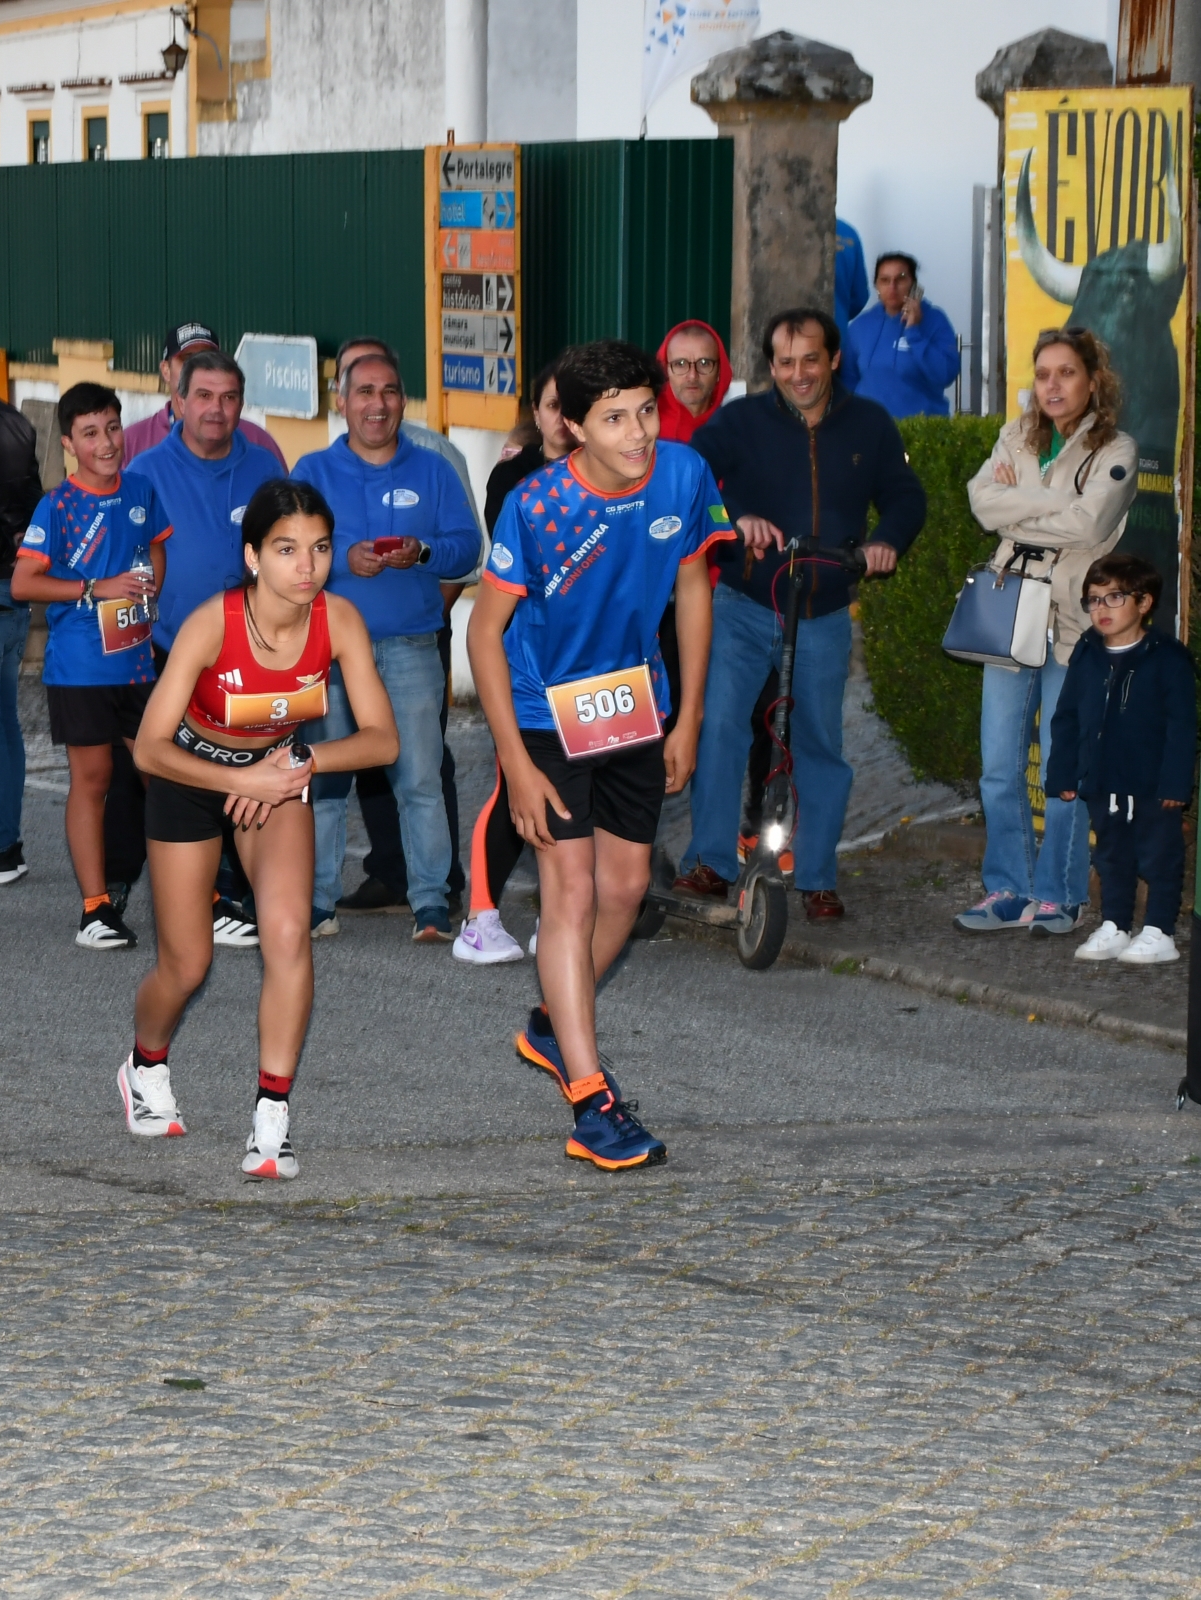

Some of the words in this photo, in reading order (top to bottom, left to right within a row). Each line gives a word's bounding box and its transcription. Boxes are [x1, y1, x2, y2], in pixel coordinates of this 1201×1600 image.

[457, 157, 512, 183] Portalegre
[443, 289, 480, 310] histórico
[443, 332, 475, 349] municipal
[265, 359, 308, 392] Piscina
[444, 361, 481, 385] turismo
[616, 500, 645, 511] SPORTS
[559, 543, 607, 595] MONFORTE
[544, 573, 562, 598] UBE
[116, 605, 138, 629] 50
[269, 698, 289, 720] 3
[574, 684, 636, 724] 506
[193, 740, 253, 763] PRO
